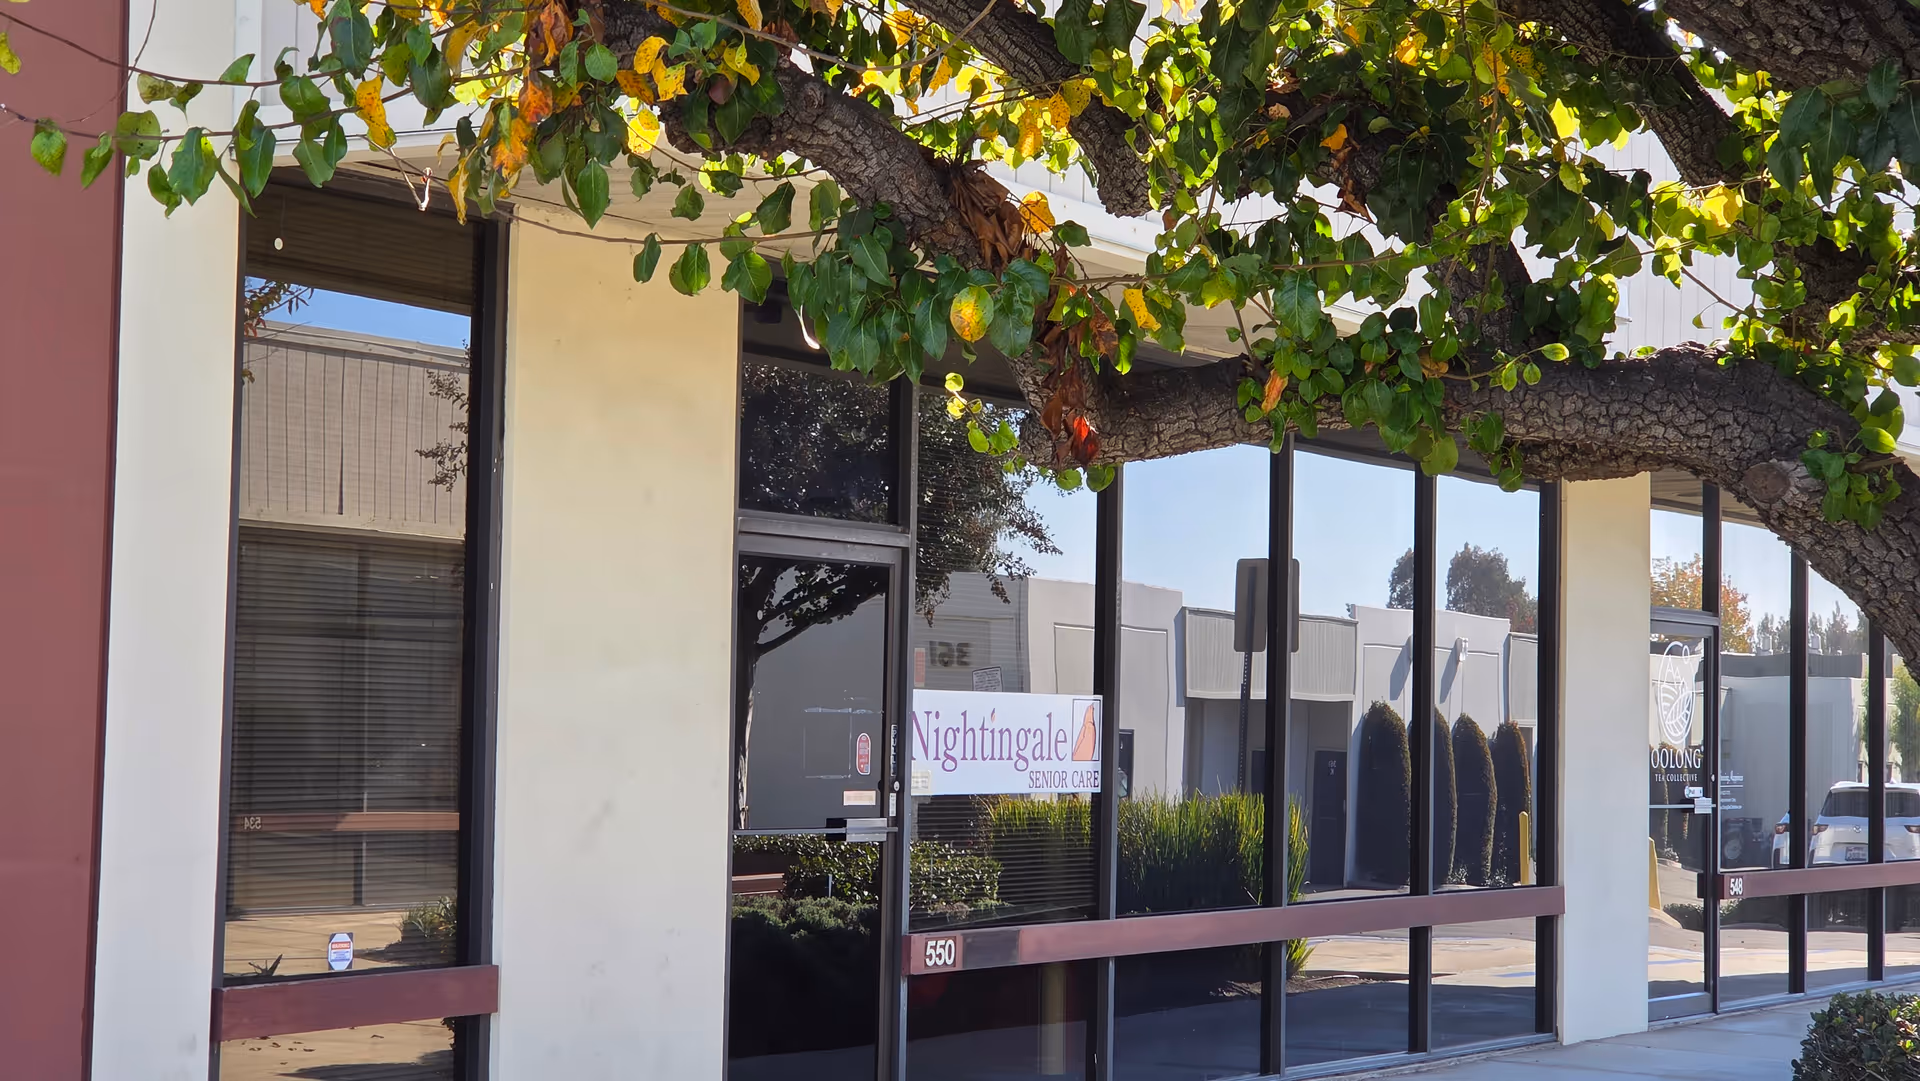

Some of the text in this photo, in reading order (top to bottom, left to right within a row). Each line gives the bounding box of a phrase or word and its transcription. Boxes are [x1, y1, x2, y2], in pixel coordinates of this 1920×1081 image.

[911, 708, 1068, 772] Nightingale
[1651, 748, 1701, 769] OOLONG
[1029, 770, 1100, 788] SENIOR CARE
[1655, 773, 1698, 782] TEA COLLECTIVE
[1730, 878, 1743, 896] 548
[925, 939, 956, 967] 550
